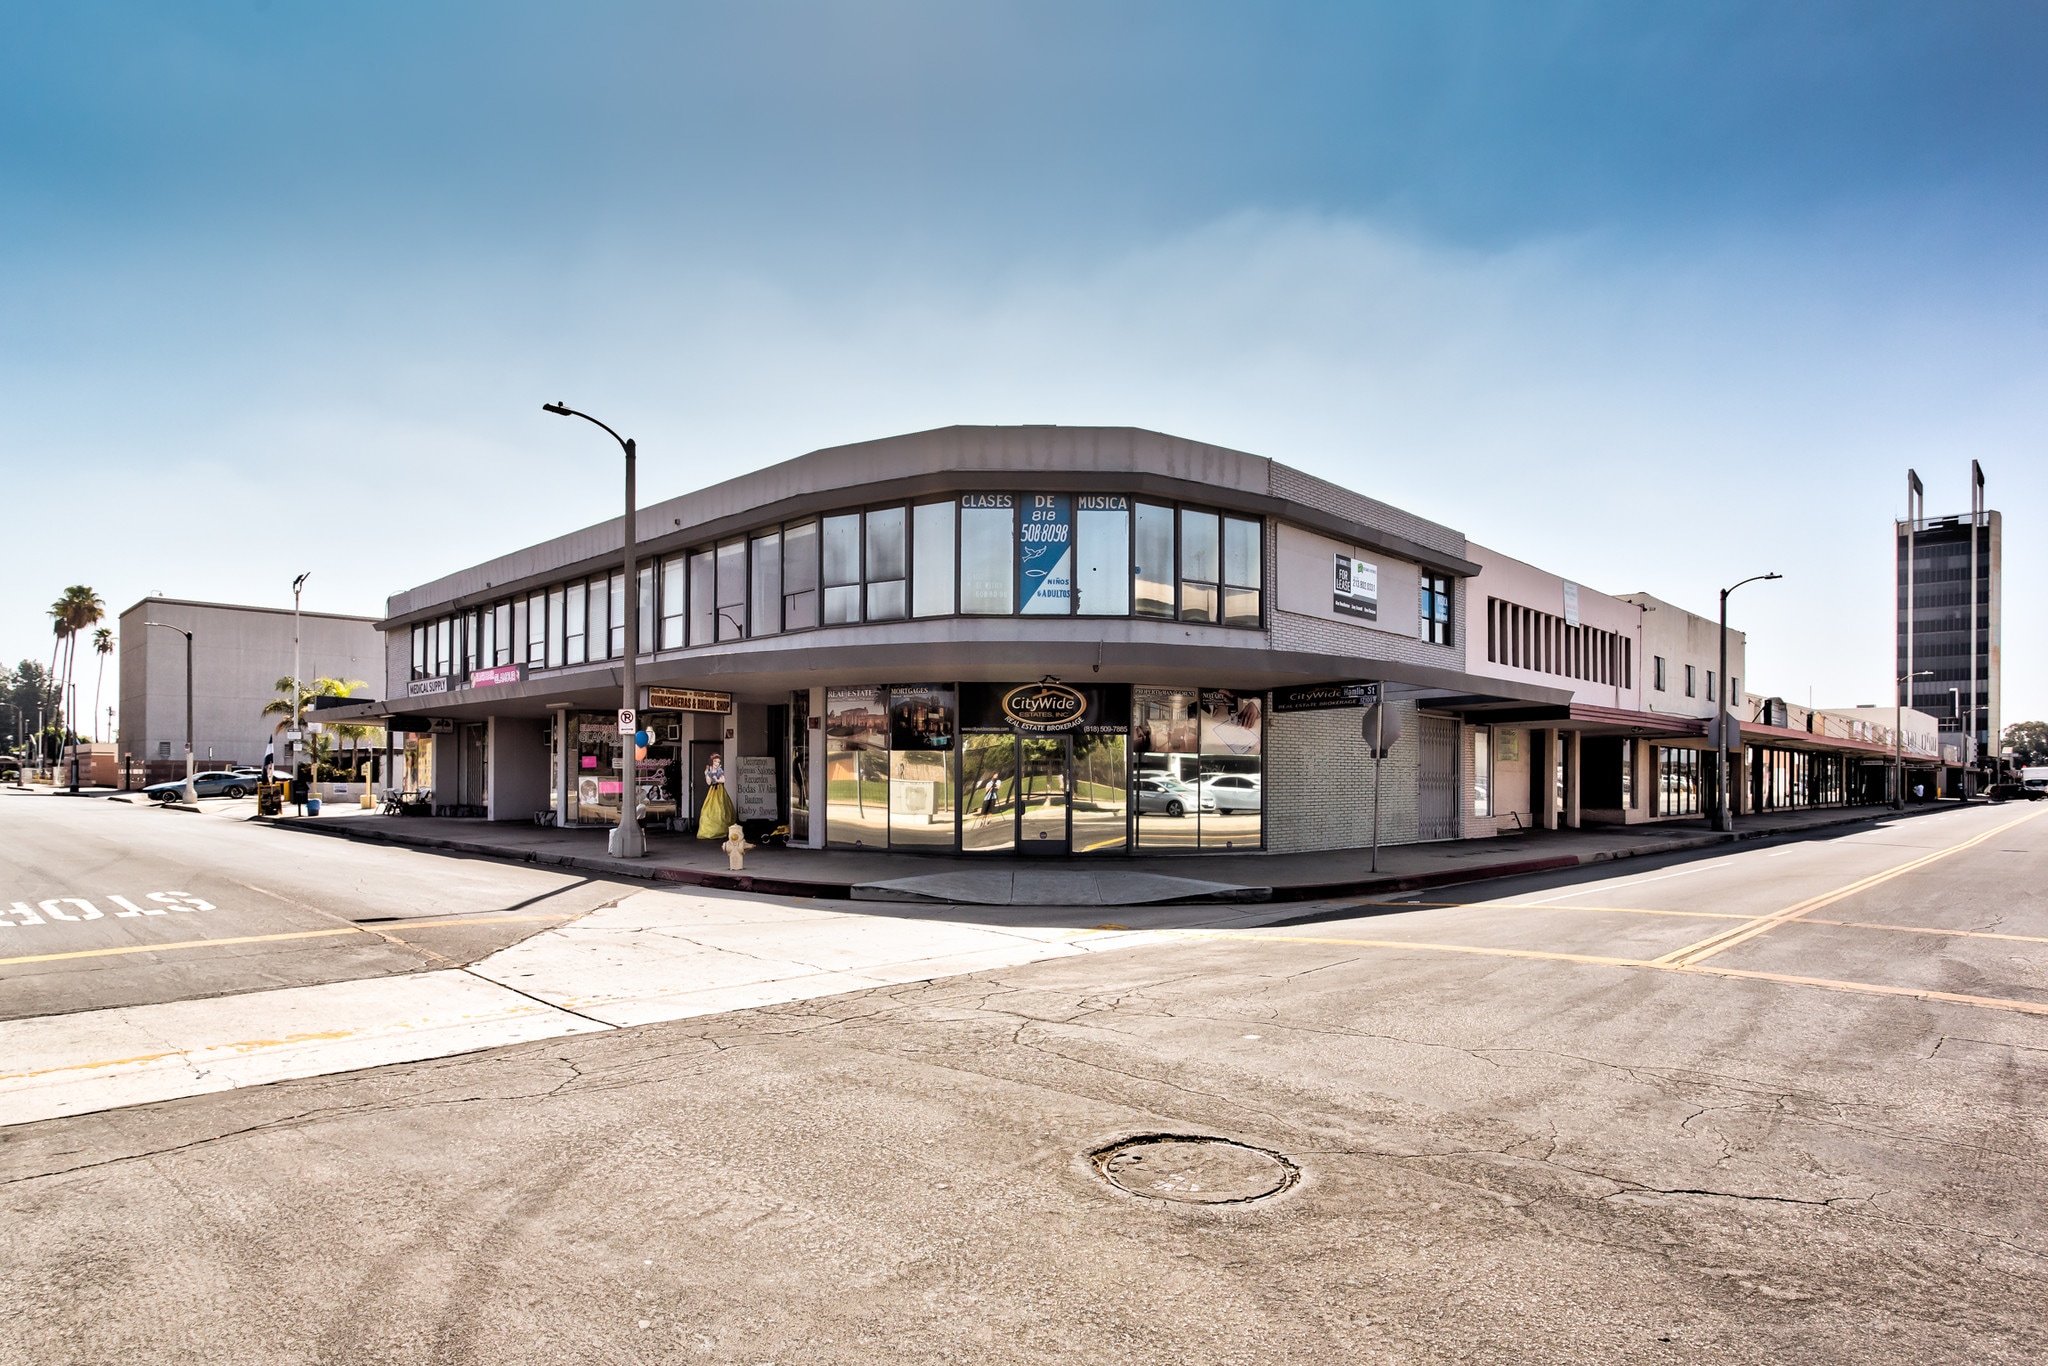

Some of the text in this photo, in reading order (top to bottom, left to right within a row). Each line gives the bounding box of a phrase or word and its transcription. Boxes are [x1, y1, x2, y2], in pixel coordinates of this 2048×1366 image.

[961, 495, 1127, 509] CLASES DE MUSICA
[1031, 510, 1056, 521] 818
[1339, 568, 1348, 580] FOR
[1047, 577, 1069, 586] NIÑOS
[1336, 578, 1350, 592] LEASE
[409, 679, 446, 694] MEDICAL SUPPLY
[890, 687, 929, 695] MORTGAGES
[1367, 686, 1376, 695] St
[847, 689, 874, 698] ESTATE
[697, 698, 715, 710] BRIDAL
[716, 700, 730, 711] SHOP
[1011, 696, 1075, 712] CityWide
[1004, 715, 1085, 732] REAL ESTATE BROKERAGE
[1083, 725, 1100, 733] (818)
[0, 891, 217, 927] STOP
